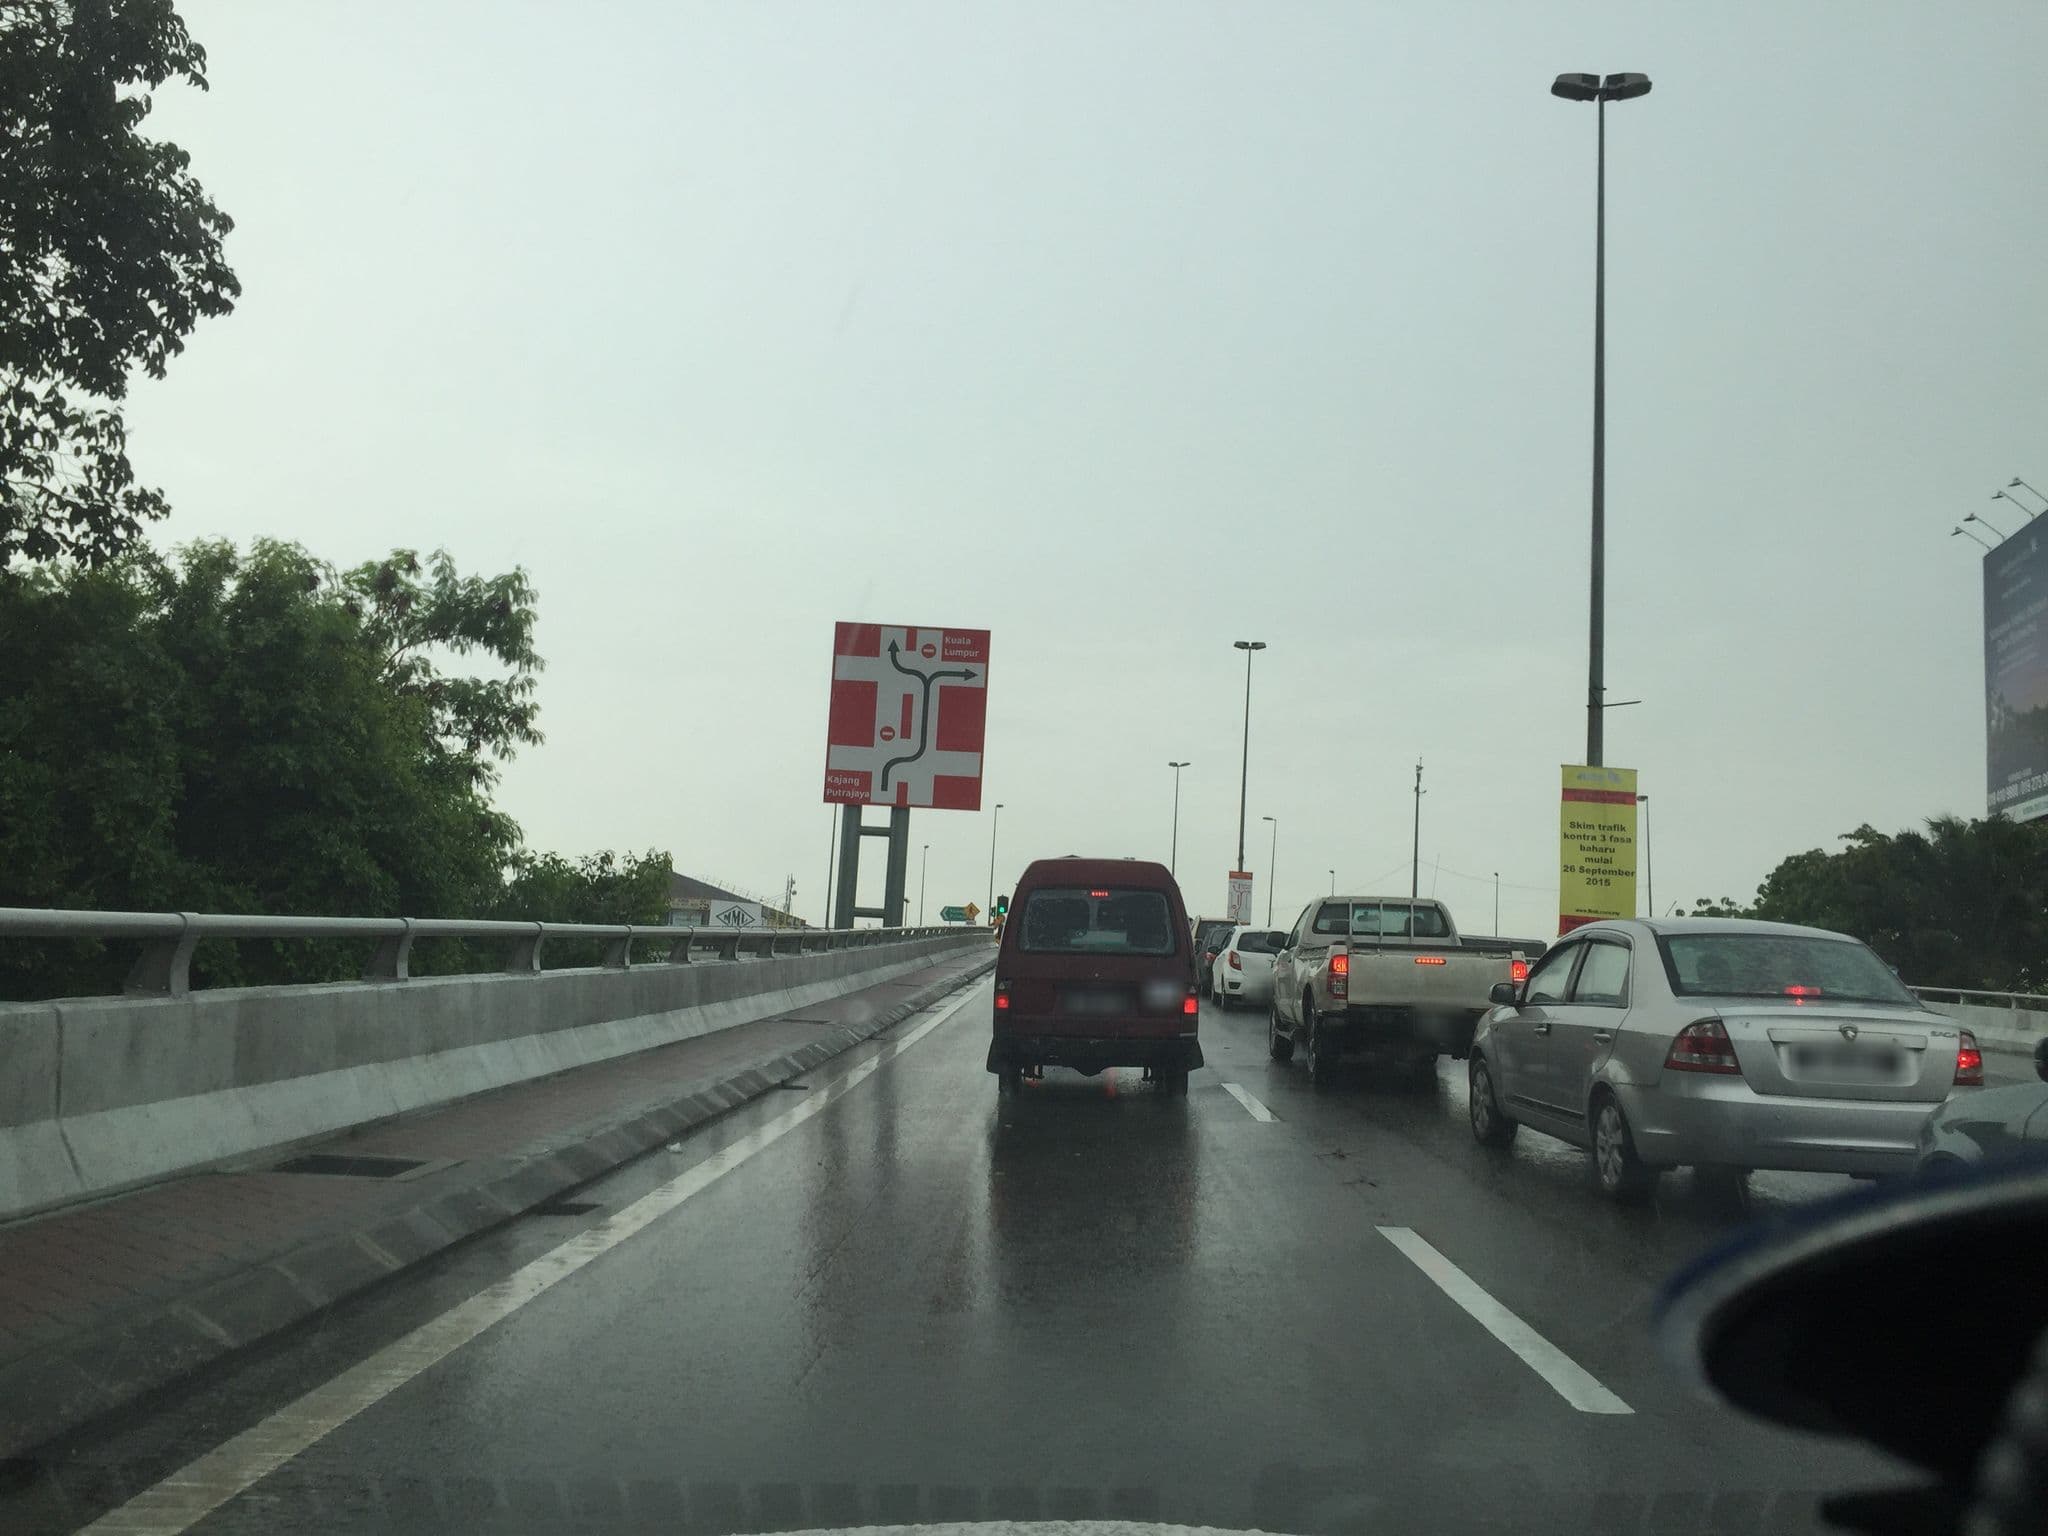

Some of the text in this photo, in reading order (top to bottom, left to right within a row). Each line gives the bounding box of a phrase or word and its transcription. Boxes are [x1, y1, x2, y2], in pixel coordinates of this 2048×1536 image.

[944, 636, 972, 645] Kuala
[944, 648, 980, 658] Lumpur
[827, 775, 860, 787] Kajang
[826, 788, 870, 799] Putrajaya
[1569, 821, 1626, 832] Skim trafik
[1563, 832, 1632, 844] kontra 3 fasa
[1579, 844, 1616, 854] baharu
[1584, 856, 1613, 865] mulai
[1563, 865, 1635, 877] 26 September
[1585, 877, 1611, 887] 2015
